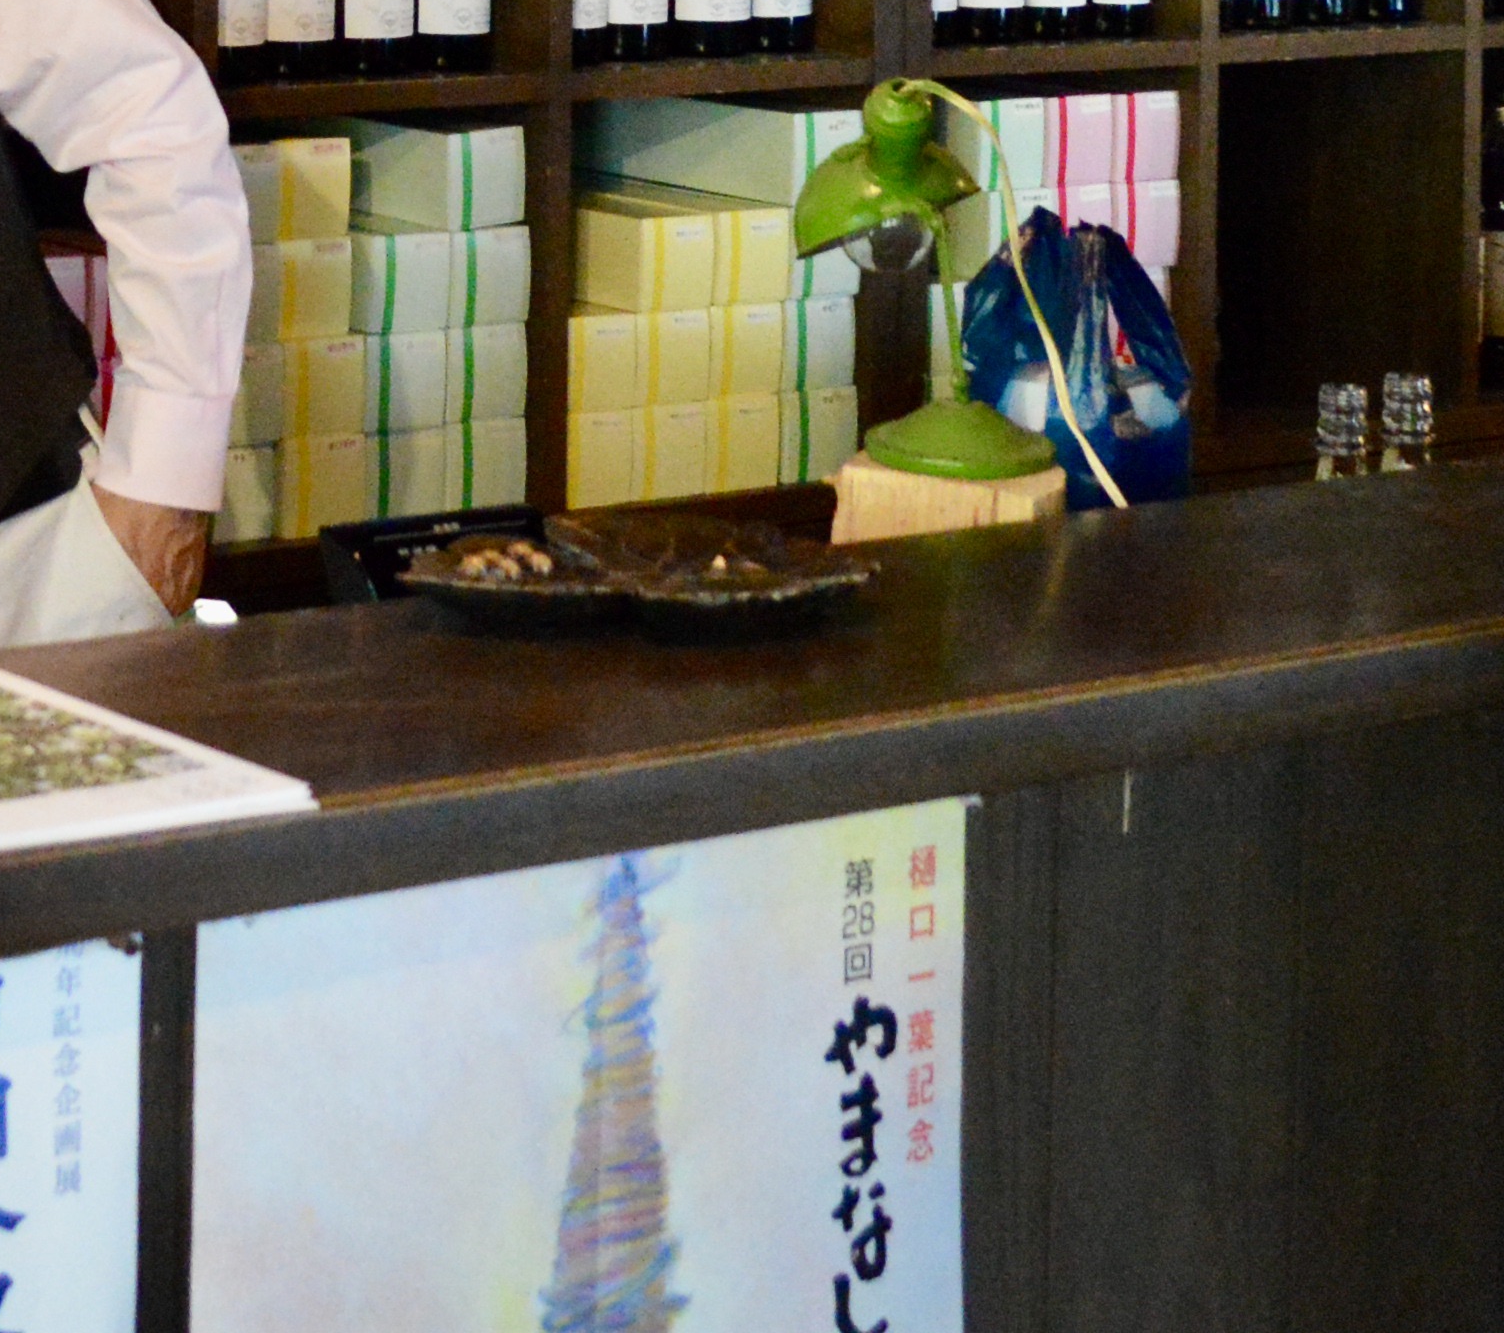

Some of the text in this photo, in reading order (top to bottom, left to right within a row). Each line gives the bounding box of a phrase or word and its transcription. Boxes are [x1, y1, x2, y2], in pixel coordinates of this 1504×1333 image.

[842, 857, 876, 985] 第28回
[906, 844, 938, 1163] 樋口一葉記念
[824, 994, 898, 1333] やまなし
